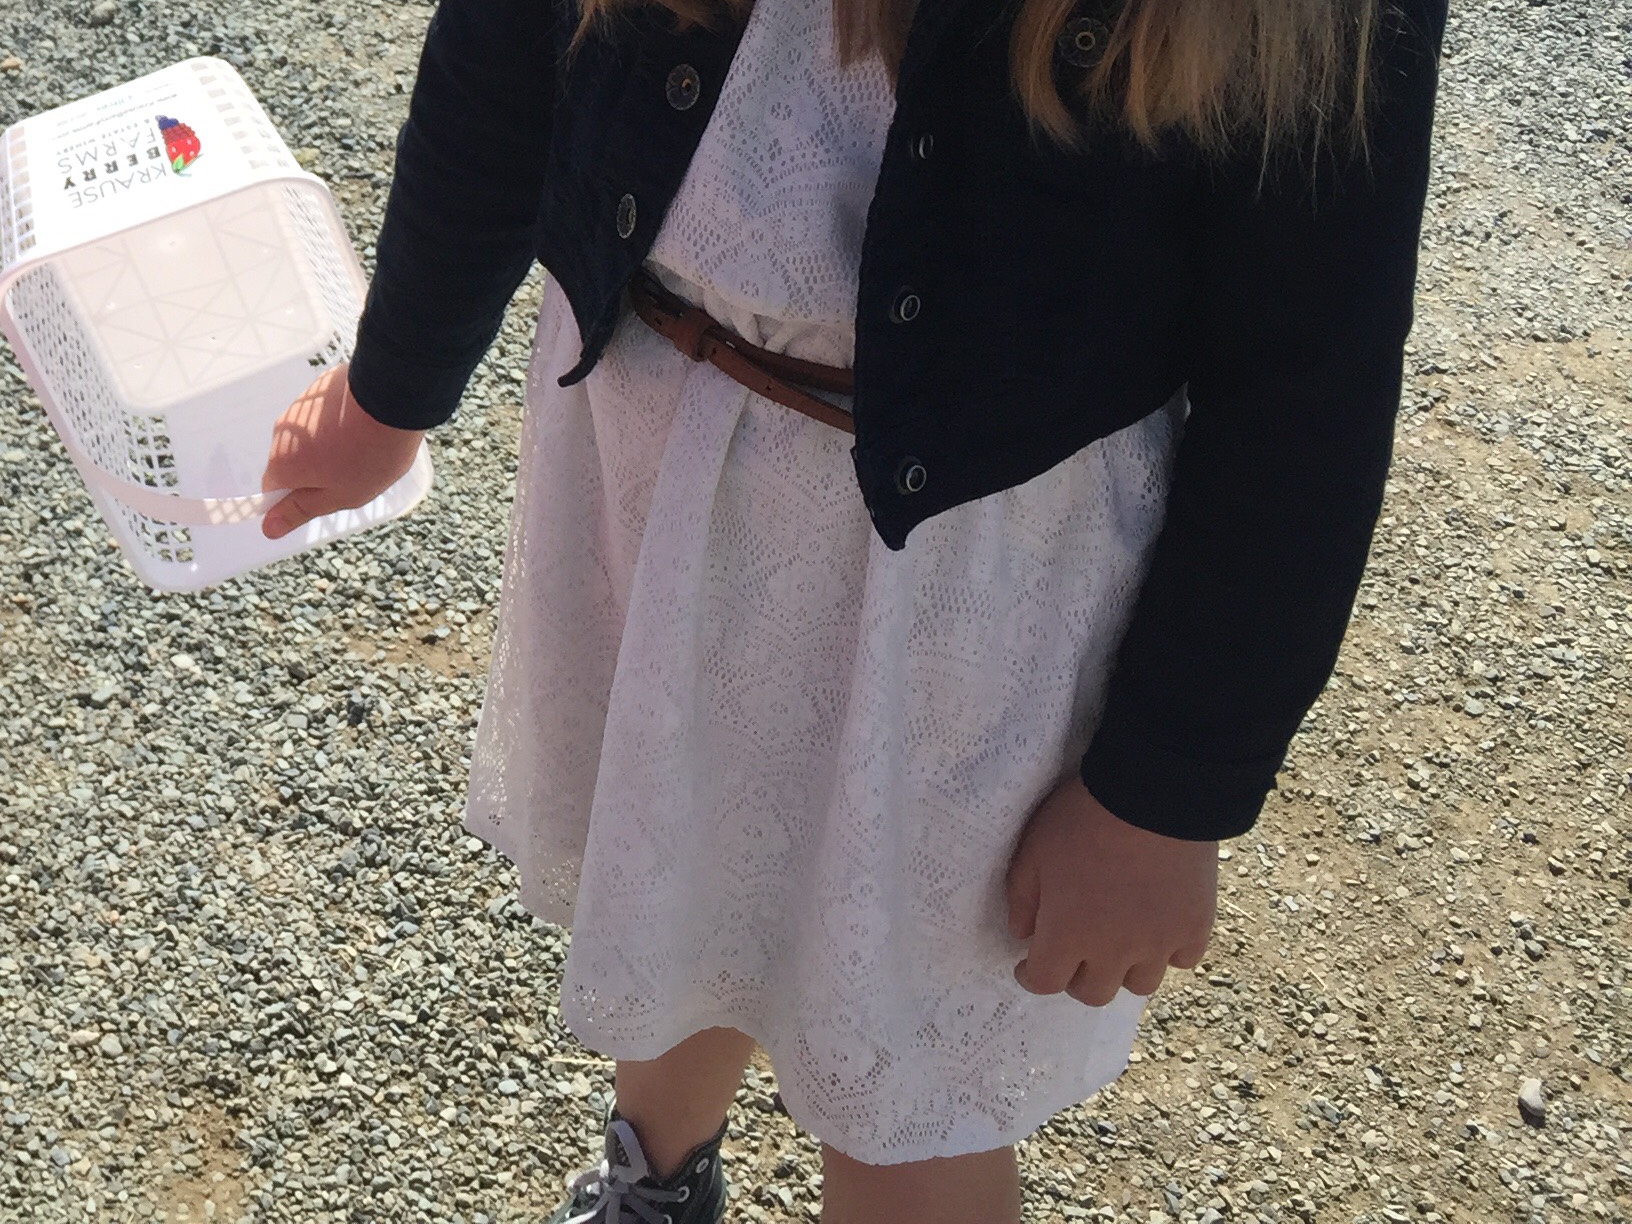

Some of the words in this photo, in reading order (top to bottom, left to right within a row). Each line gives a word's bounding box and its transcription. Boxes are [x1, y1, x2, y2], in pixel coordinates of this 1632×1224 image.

[56, 137, 97, 156] WINERY
[57, 127, 157, 174] FARMS
[101, 122, 139, 140] ESTATE
[64, 146, 162, 190] BERRY
[68, 162, 167, 209] KRAUSE
